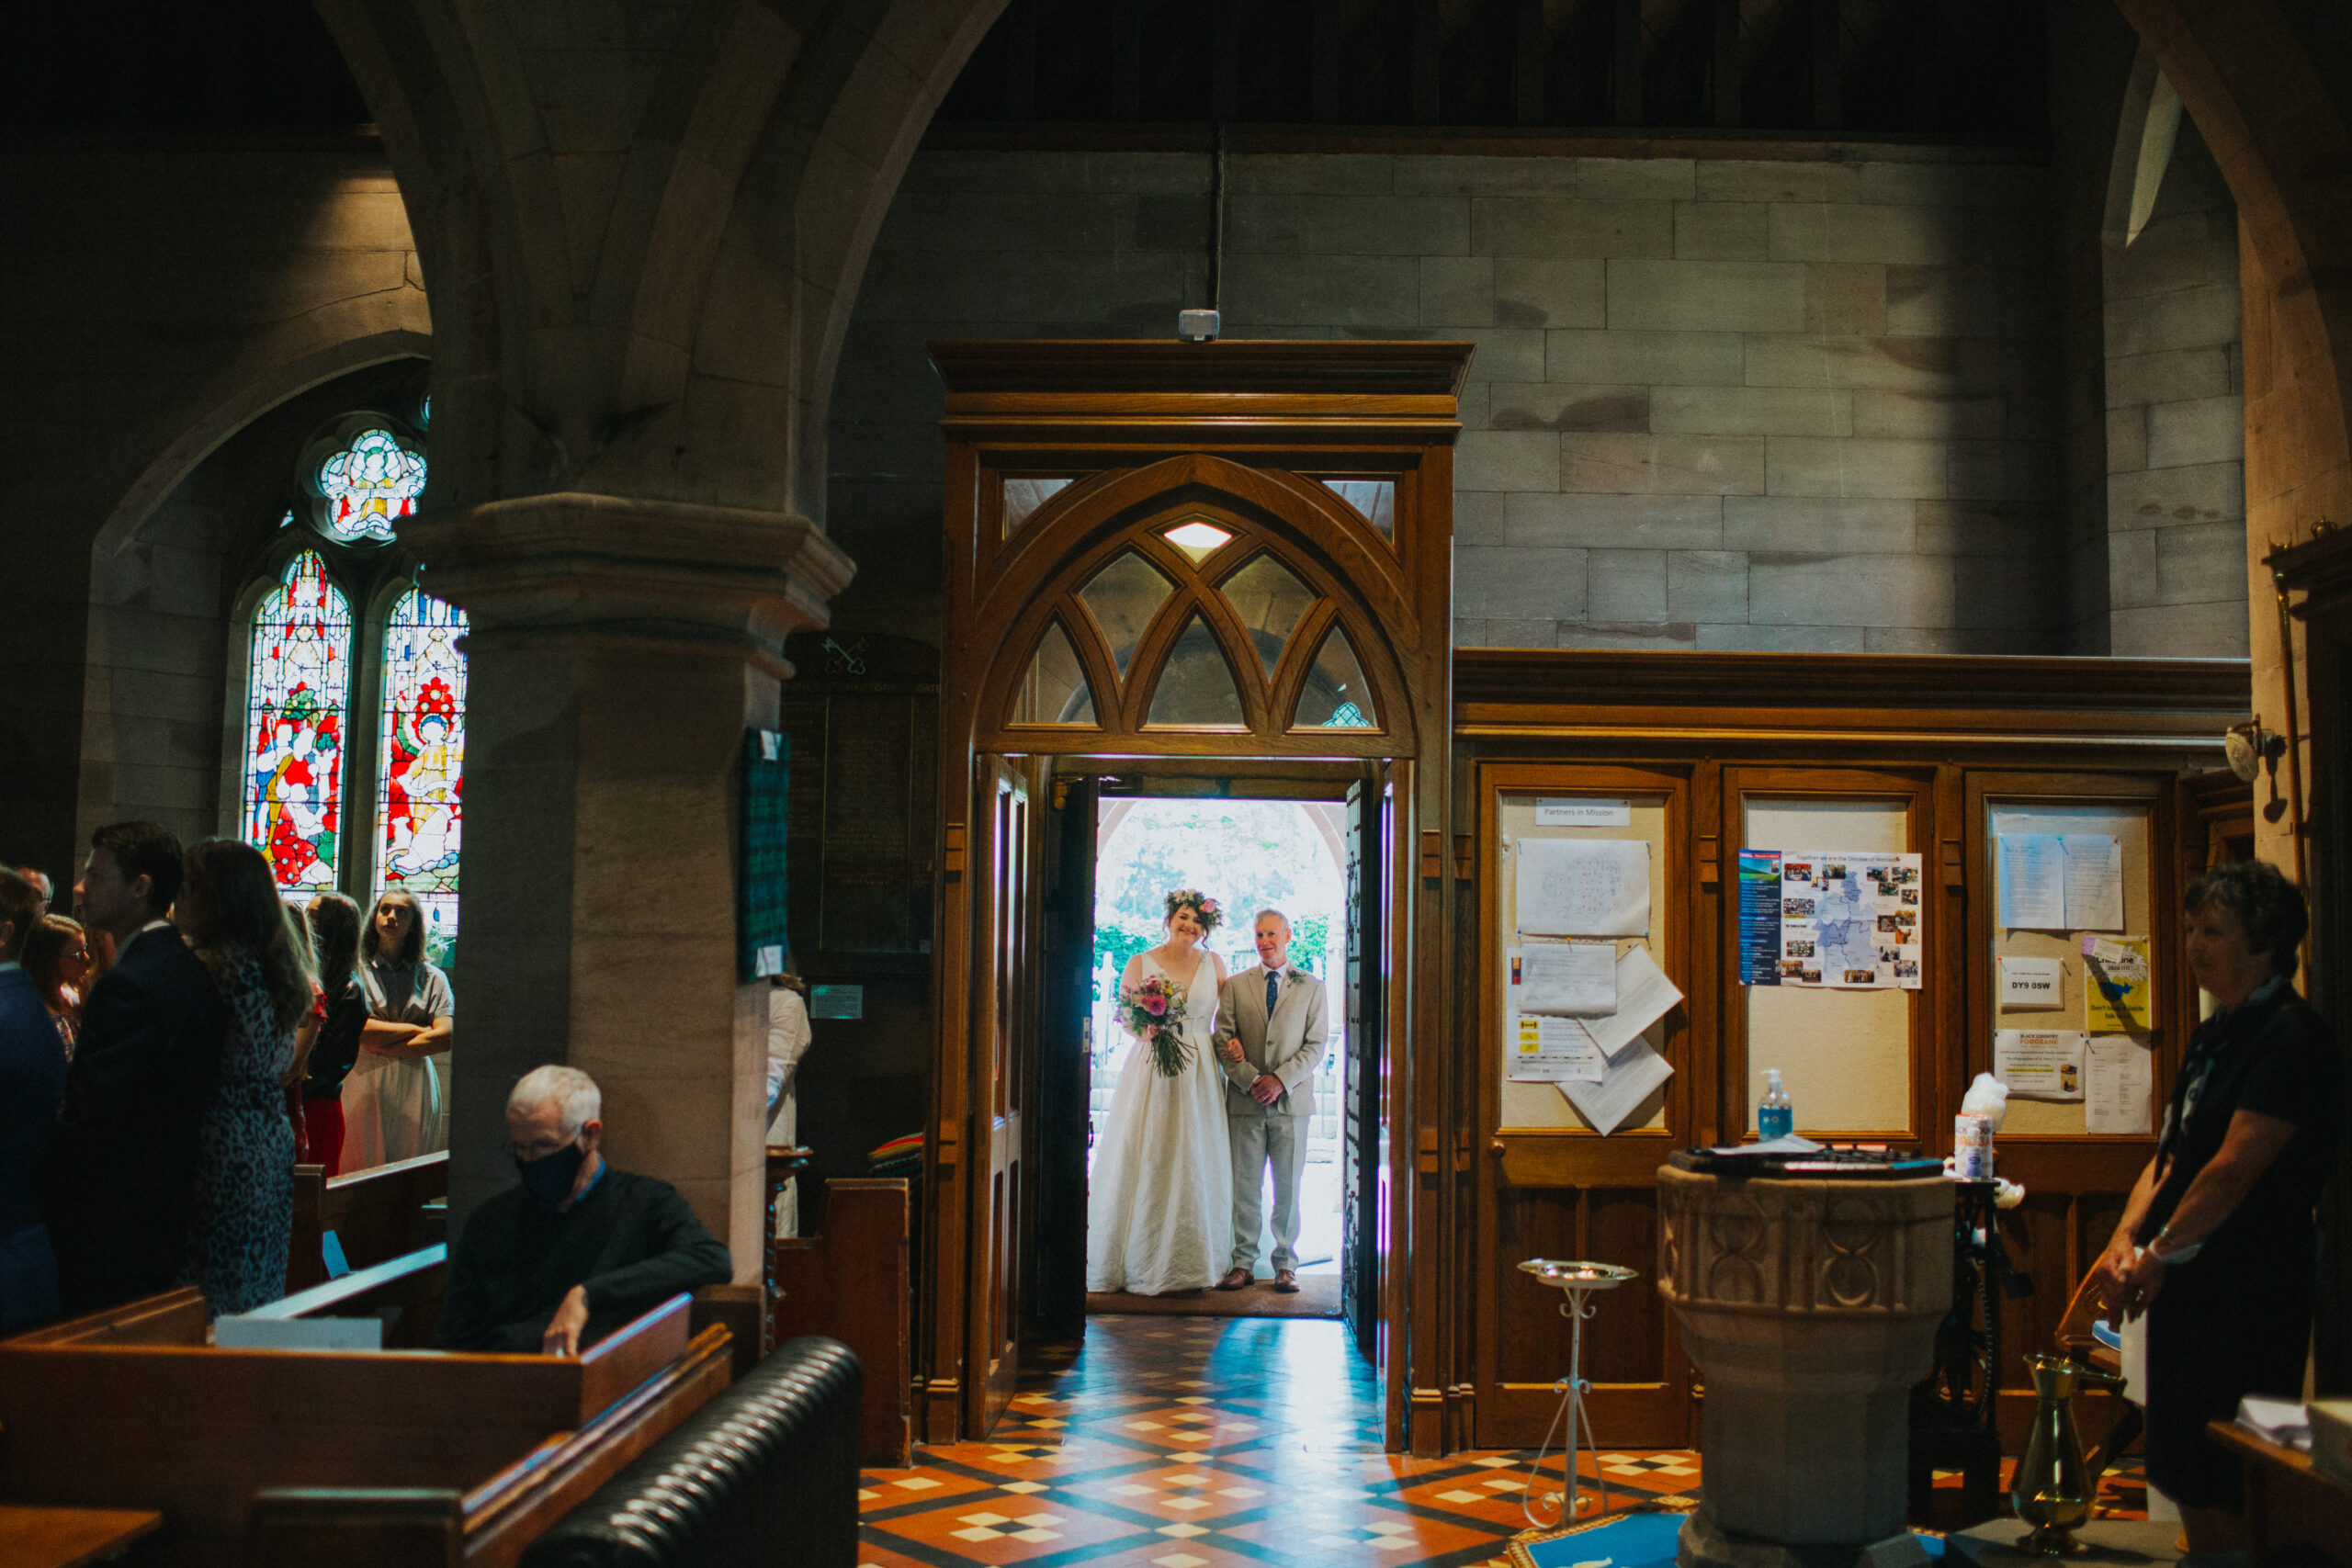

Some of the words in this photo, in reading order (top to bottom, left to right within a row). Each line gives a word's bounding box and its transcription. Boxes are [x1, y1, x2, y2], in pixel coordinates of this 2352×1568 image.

[1544, 807, 1576, 817] Partners
[1577, 808, 1585, 817] in
[1586, 808, 1614, 817] Mission
[2012, 981, 2030, 989] DY9
